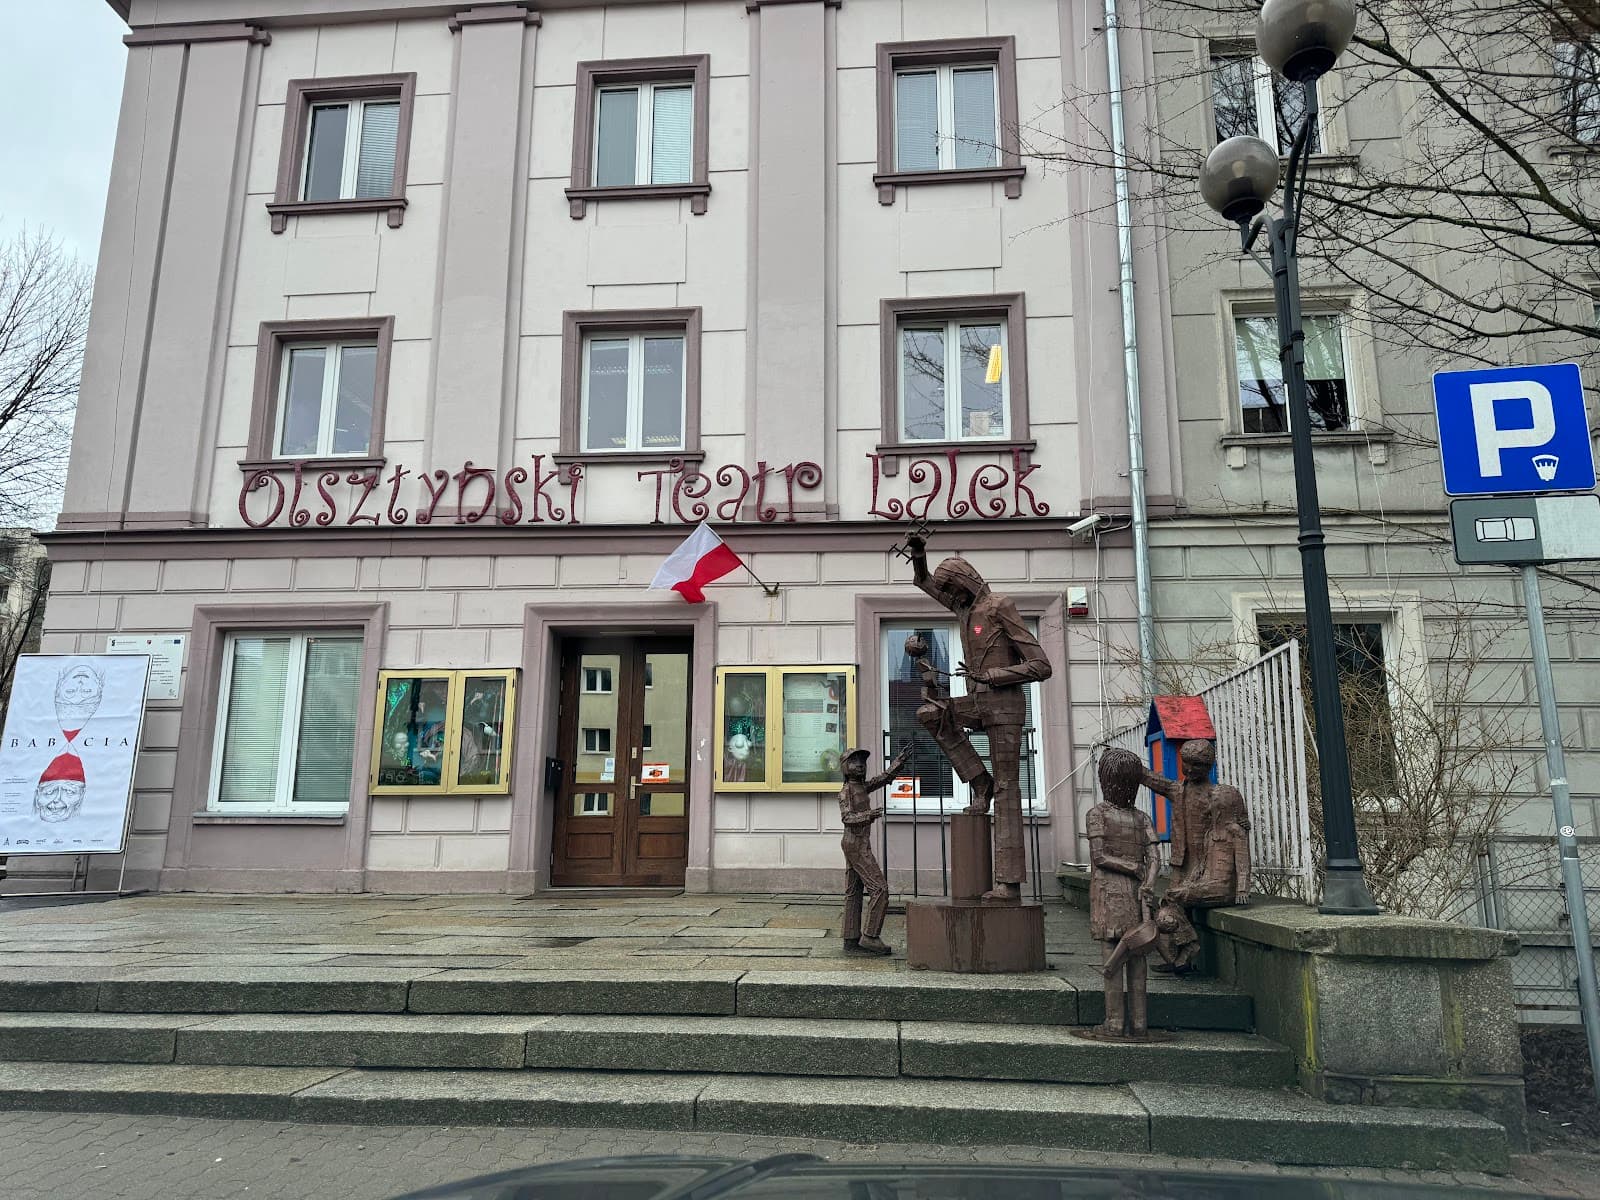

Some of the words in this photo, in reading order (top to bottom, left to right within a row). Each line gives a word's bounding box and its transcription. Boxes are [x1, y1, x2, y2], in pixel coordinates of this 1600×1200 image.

[1469, 380, 1556, 478] P
[637, 456, 823, 523] Teatr
[866, 448, 1051, 519] Lalek
